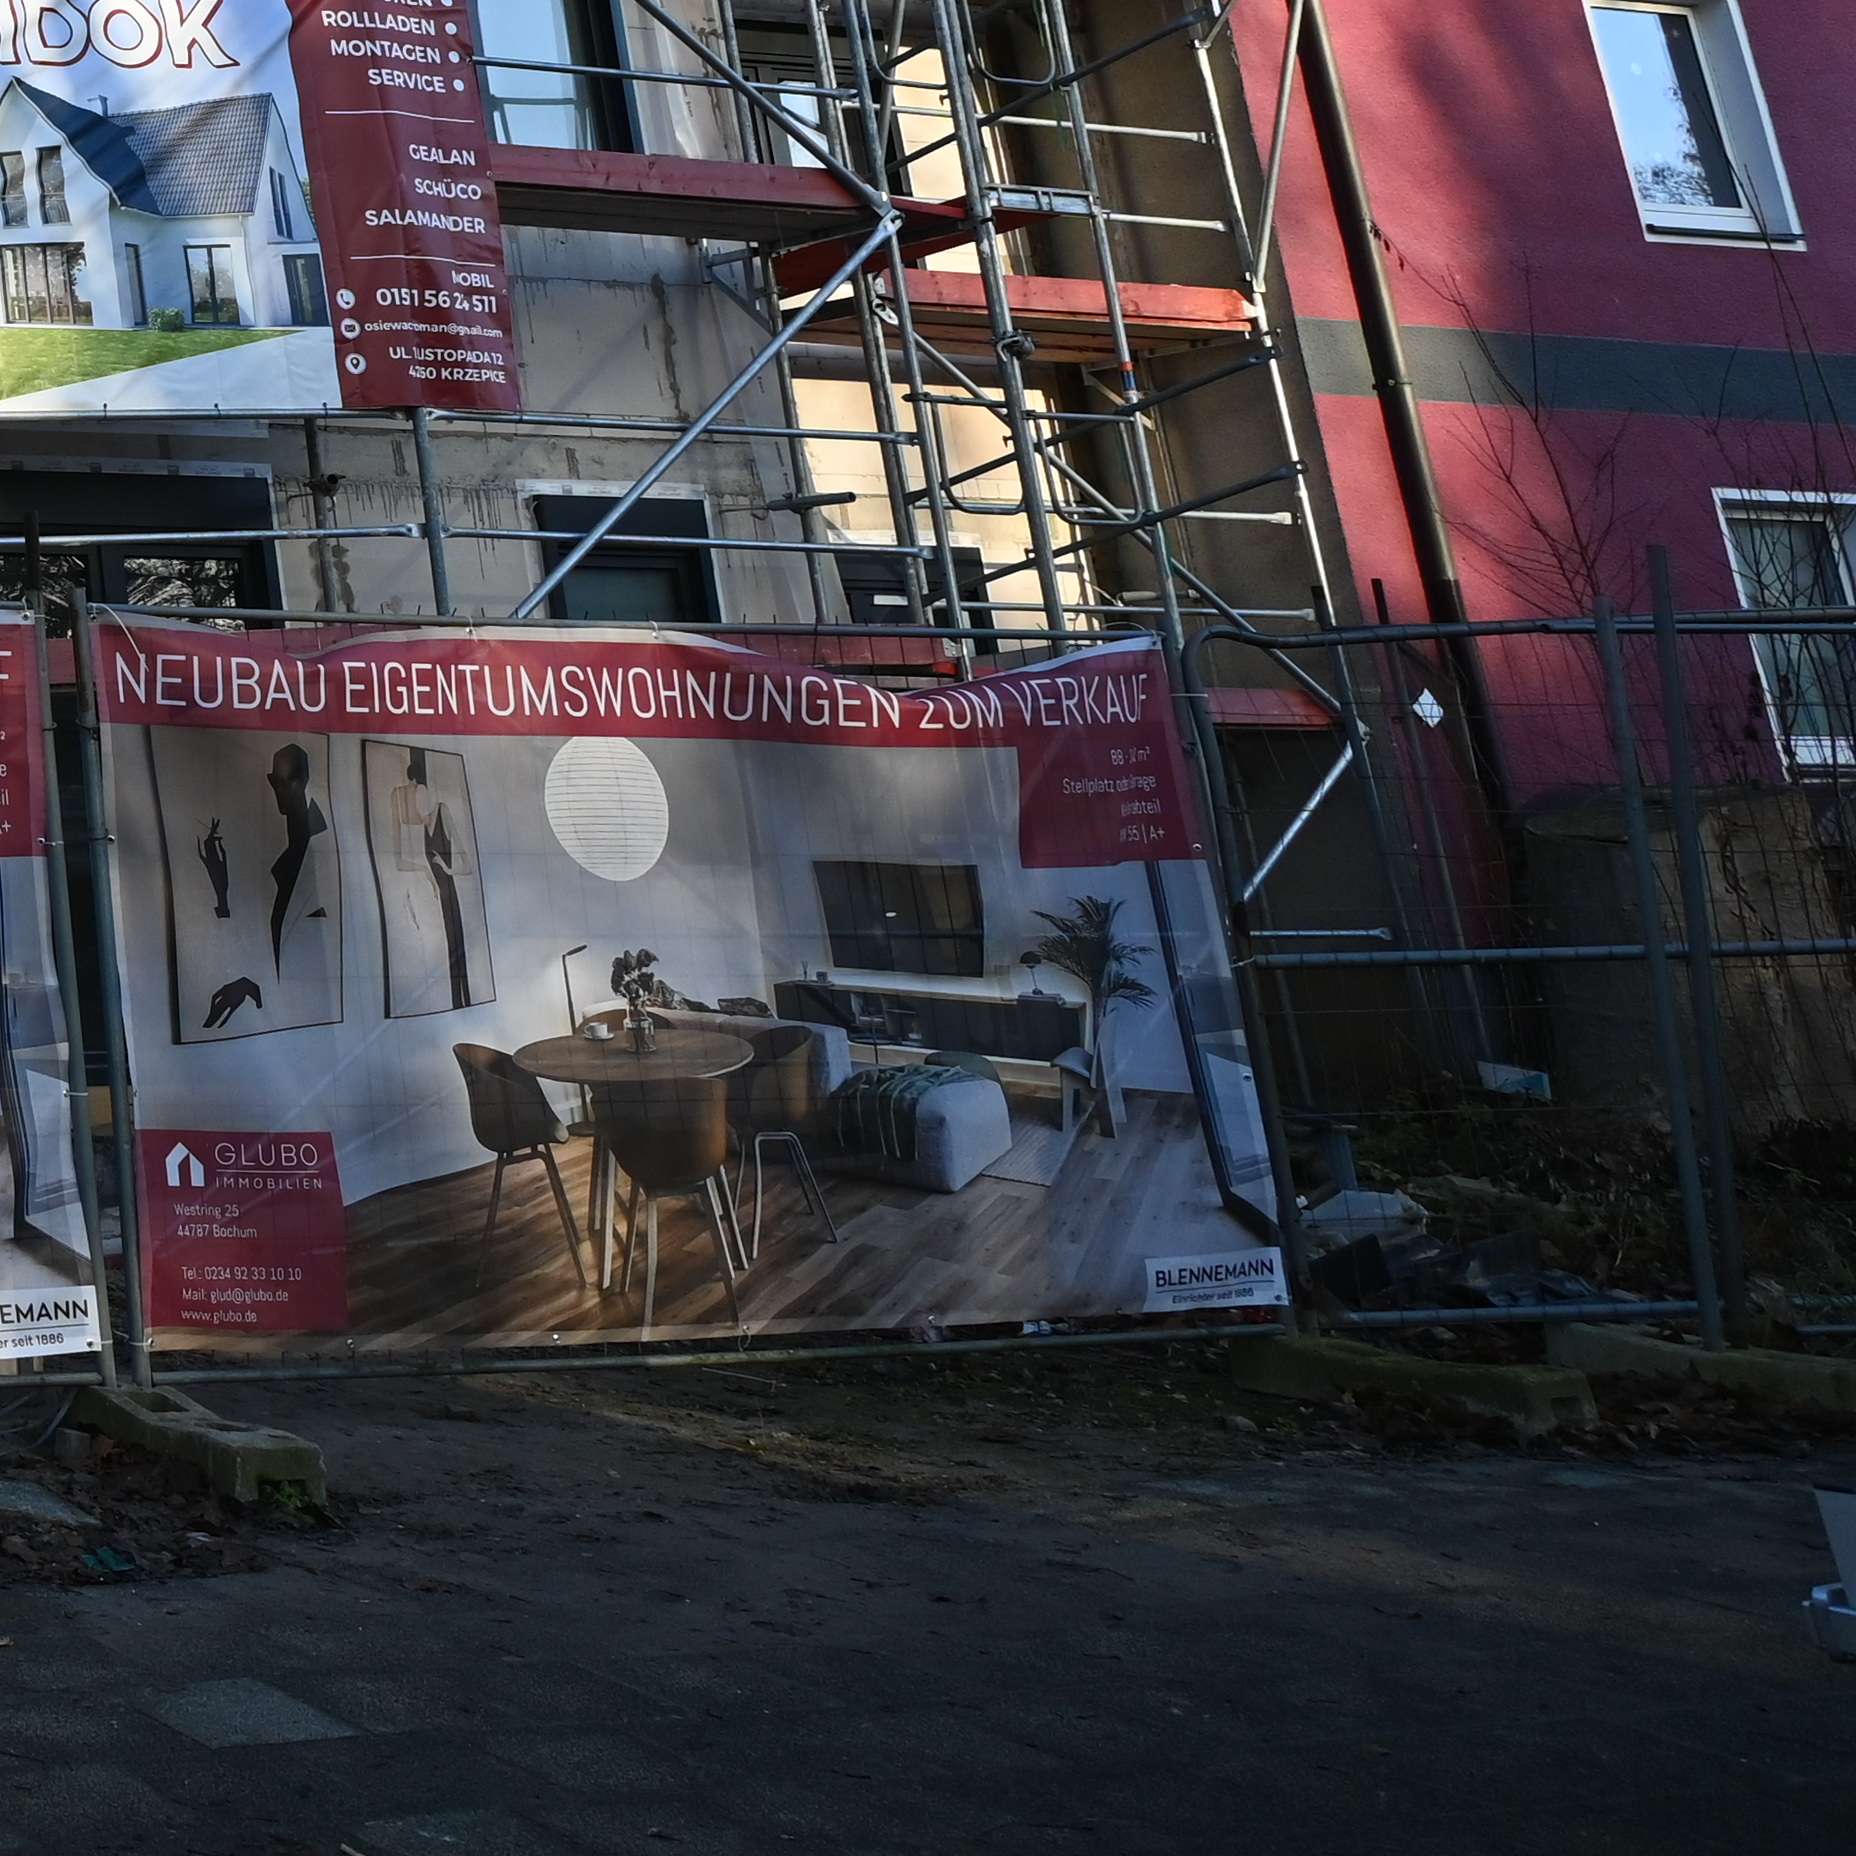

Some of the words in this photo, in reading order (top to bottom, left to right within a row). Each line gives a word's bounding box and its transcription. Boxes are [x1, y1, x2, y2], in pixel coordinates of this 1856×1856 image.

[321, 10, 436, 36] ROLLLADEN
[330, 39, 441, 64] MONTAGEN
[368, 69, 446, 94] SERVICE
[409, 144, 476, 167] GEALAN
[415, 177, 481, 200] SCHÜCO
[365, 209, 486, 234] SALAMANDER
[424, 290, 450, 308] 56
[114, 651, 326, 713] NEUBAU
[343, 660, 901, 730] EIGENTUMSWOHNUNGEN
[919, 687, 1003, 730] ZUM
[1017, 673, 1148, 729] VERKAUF
[1062, 778, 1115, 798] Stellplatz
[214, 1142, 318, 1167] GLUBO
[215, 1176, 322, 1190] IMMOBILIEN
[174, 1203, 222, 1219] Westring
[225, 1204, 240, 1217] 25
[177, 1223, 209, 1237] 44787
[213, 1224, 257, 1239] Bochum
[205, 1266, 231, 1280] 0234
[235, 1267, 248, 1280] 92
[253, 1267, 266, 1280] 33
[271, 1268, 285, 1281] 10
[289, 1268, 302, 1281] 10
[1155, 1258, 1275, 1288] BLENNEMANN
[181, 1310, 257, 1325] www.glubo.de
[12, 1334, 34, 1348] seit
[36, 1332, 65, 1346] 1886
